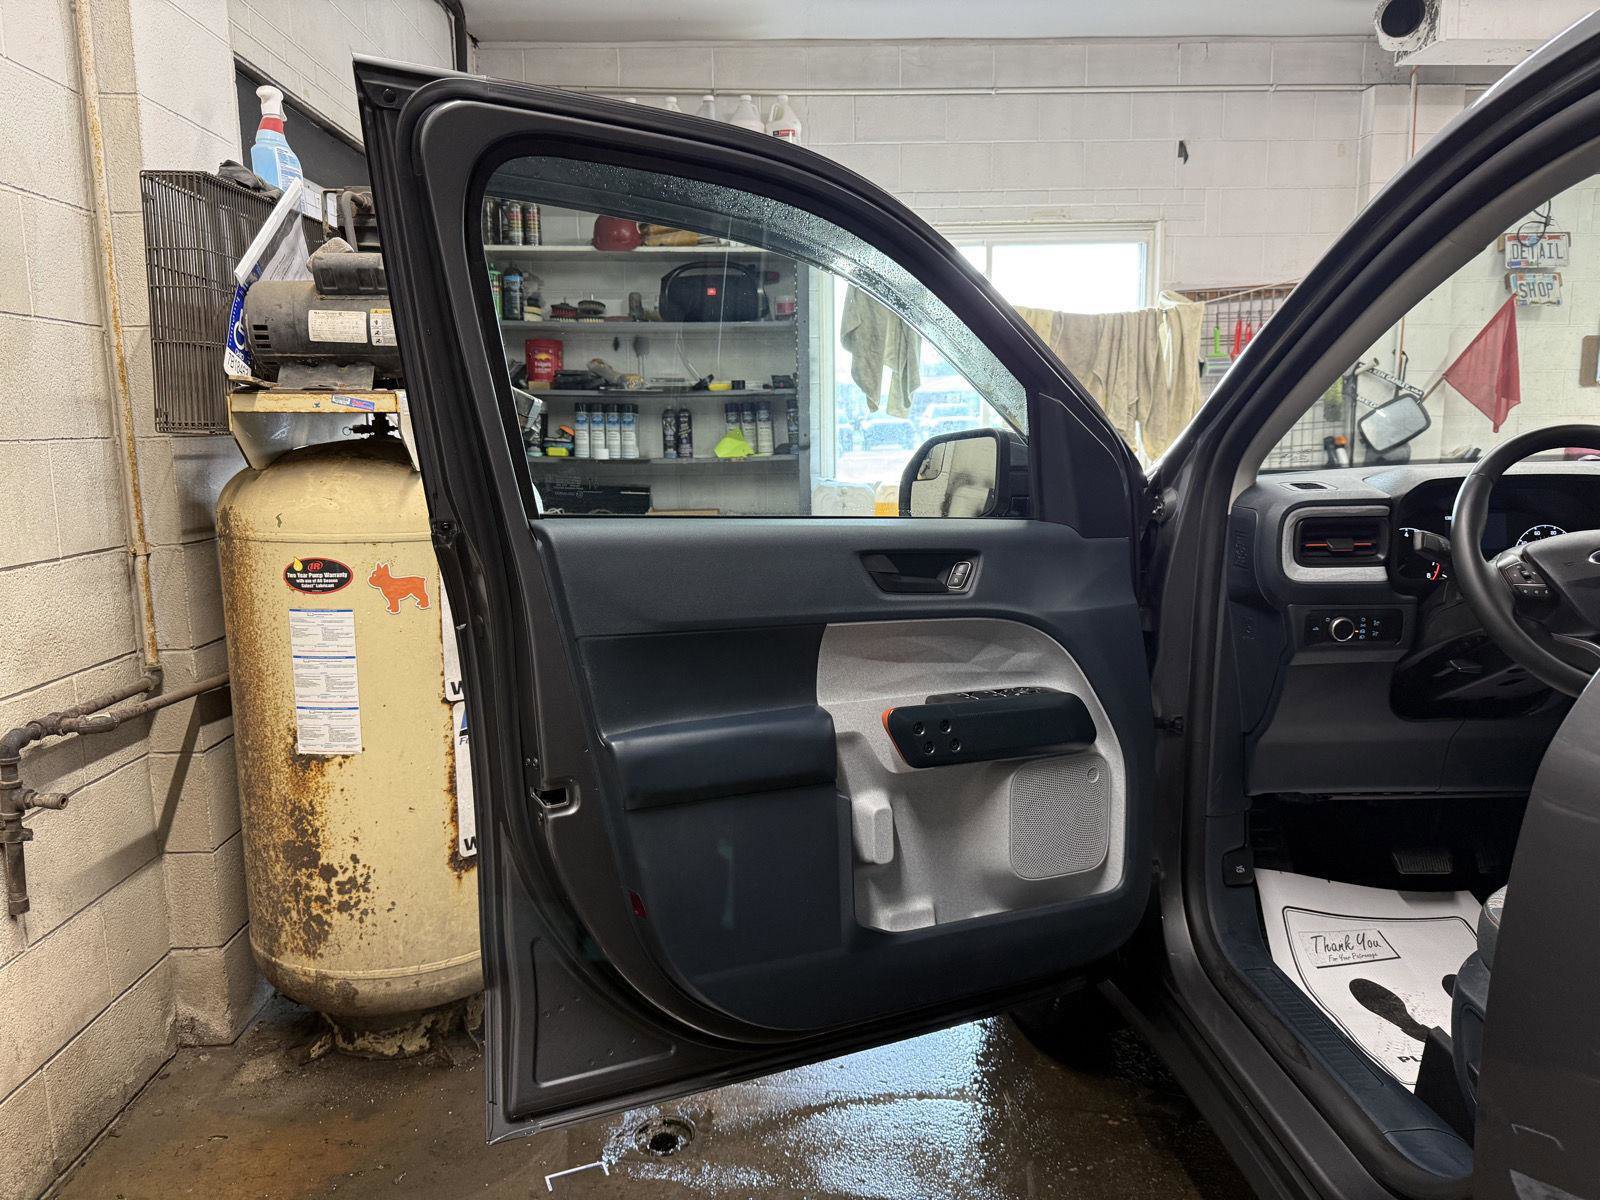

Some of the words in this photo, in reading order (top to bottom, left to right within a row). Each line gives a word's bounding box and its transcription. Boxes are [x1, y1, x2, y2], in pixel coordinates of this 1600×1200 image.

[1511, 242, 1564, 260] DETAIL
[1518, 281, 1554, 299] SHOP
[1310, 934, 1355, 954] Thank
[1356, 932, 1381, 950] You
